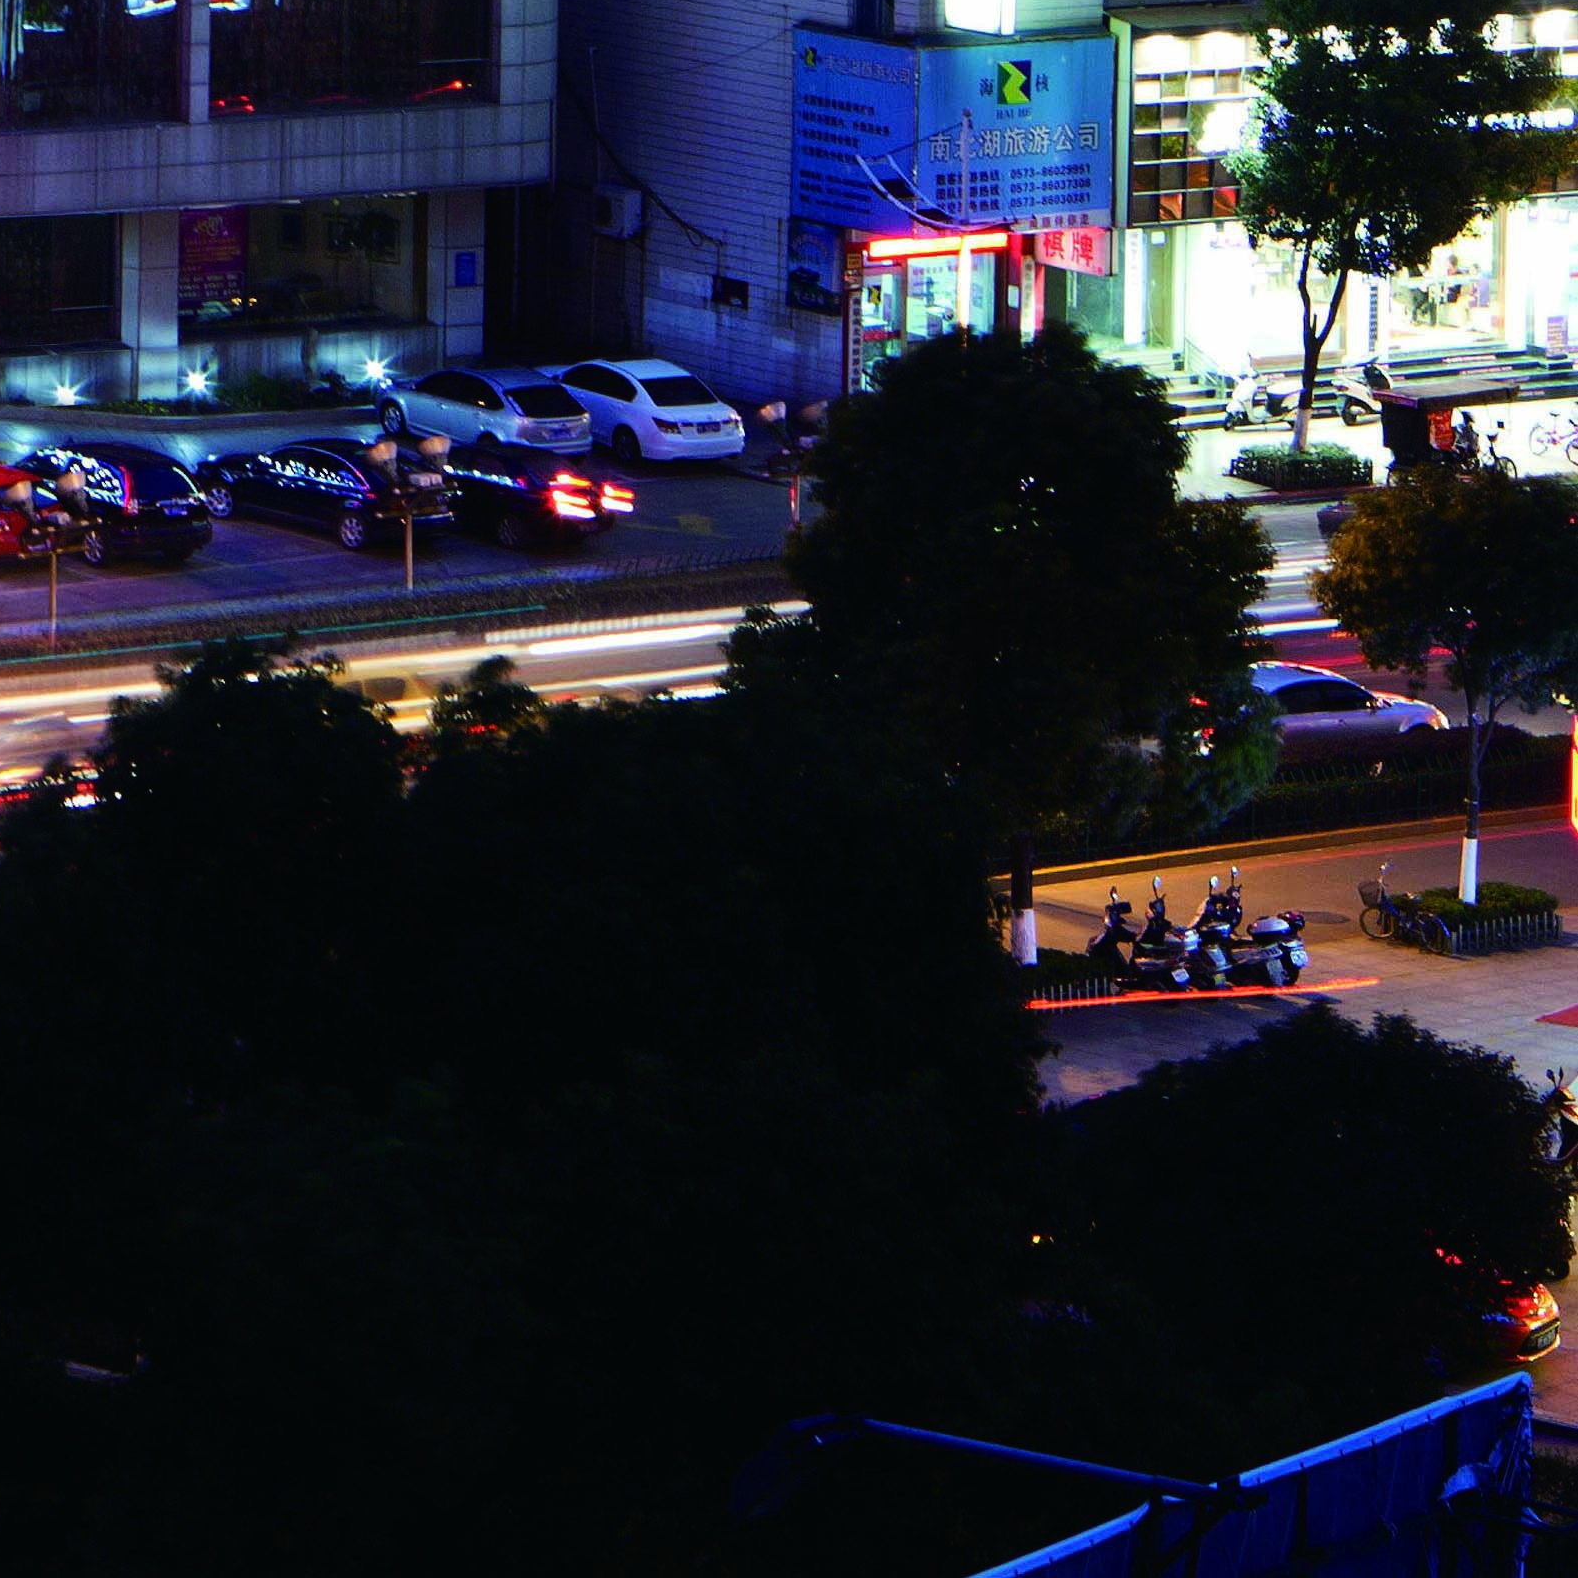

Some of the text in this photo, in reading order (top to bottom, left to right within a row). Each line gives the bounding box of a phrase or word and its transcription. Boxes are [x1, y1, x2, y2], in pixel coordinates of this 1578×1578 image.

[928, 122, 1100, 163] 南北湖旅游公司
[1043, 231, 1094, 267] 棋牌
